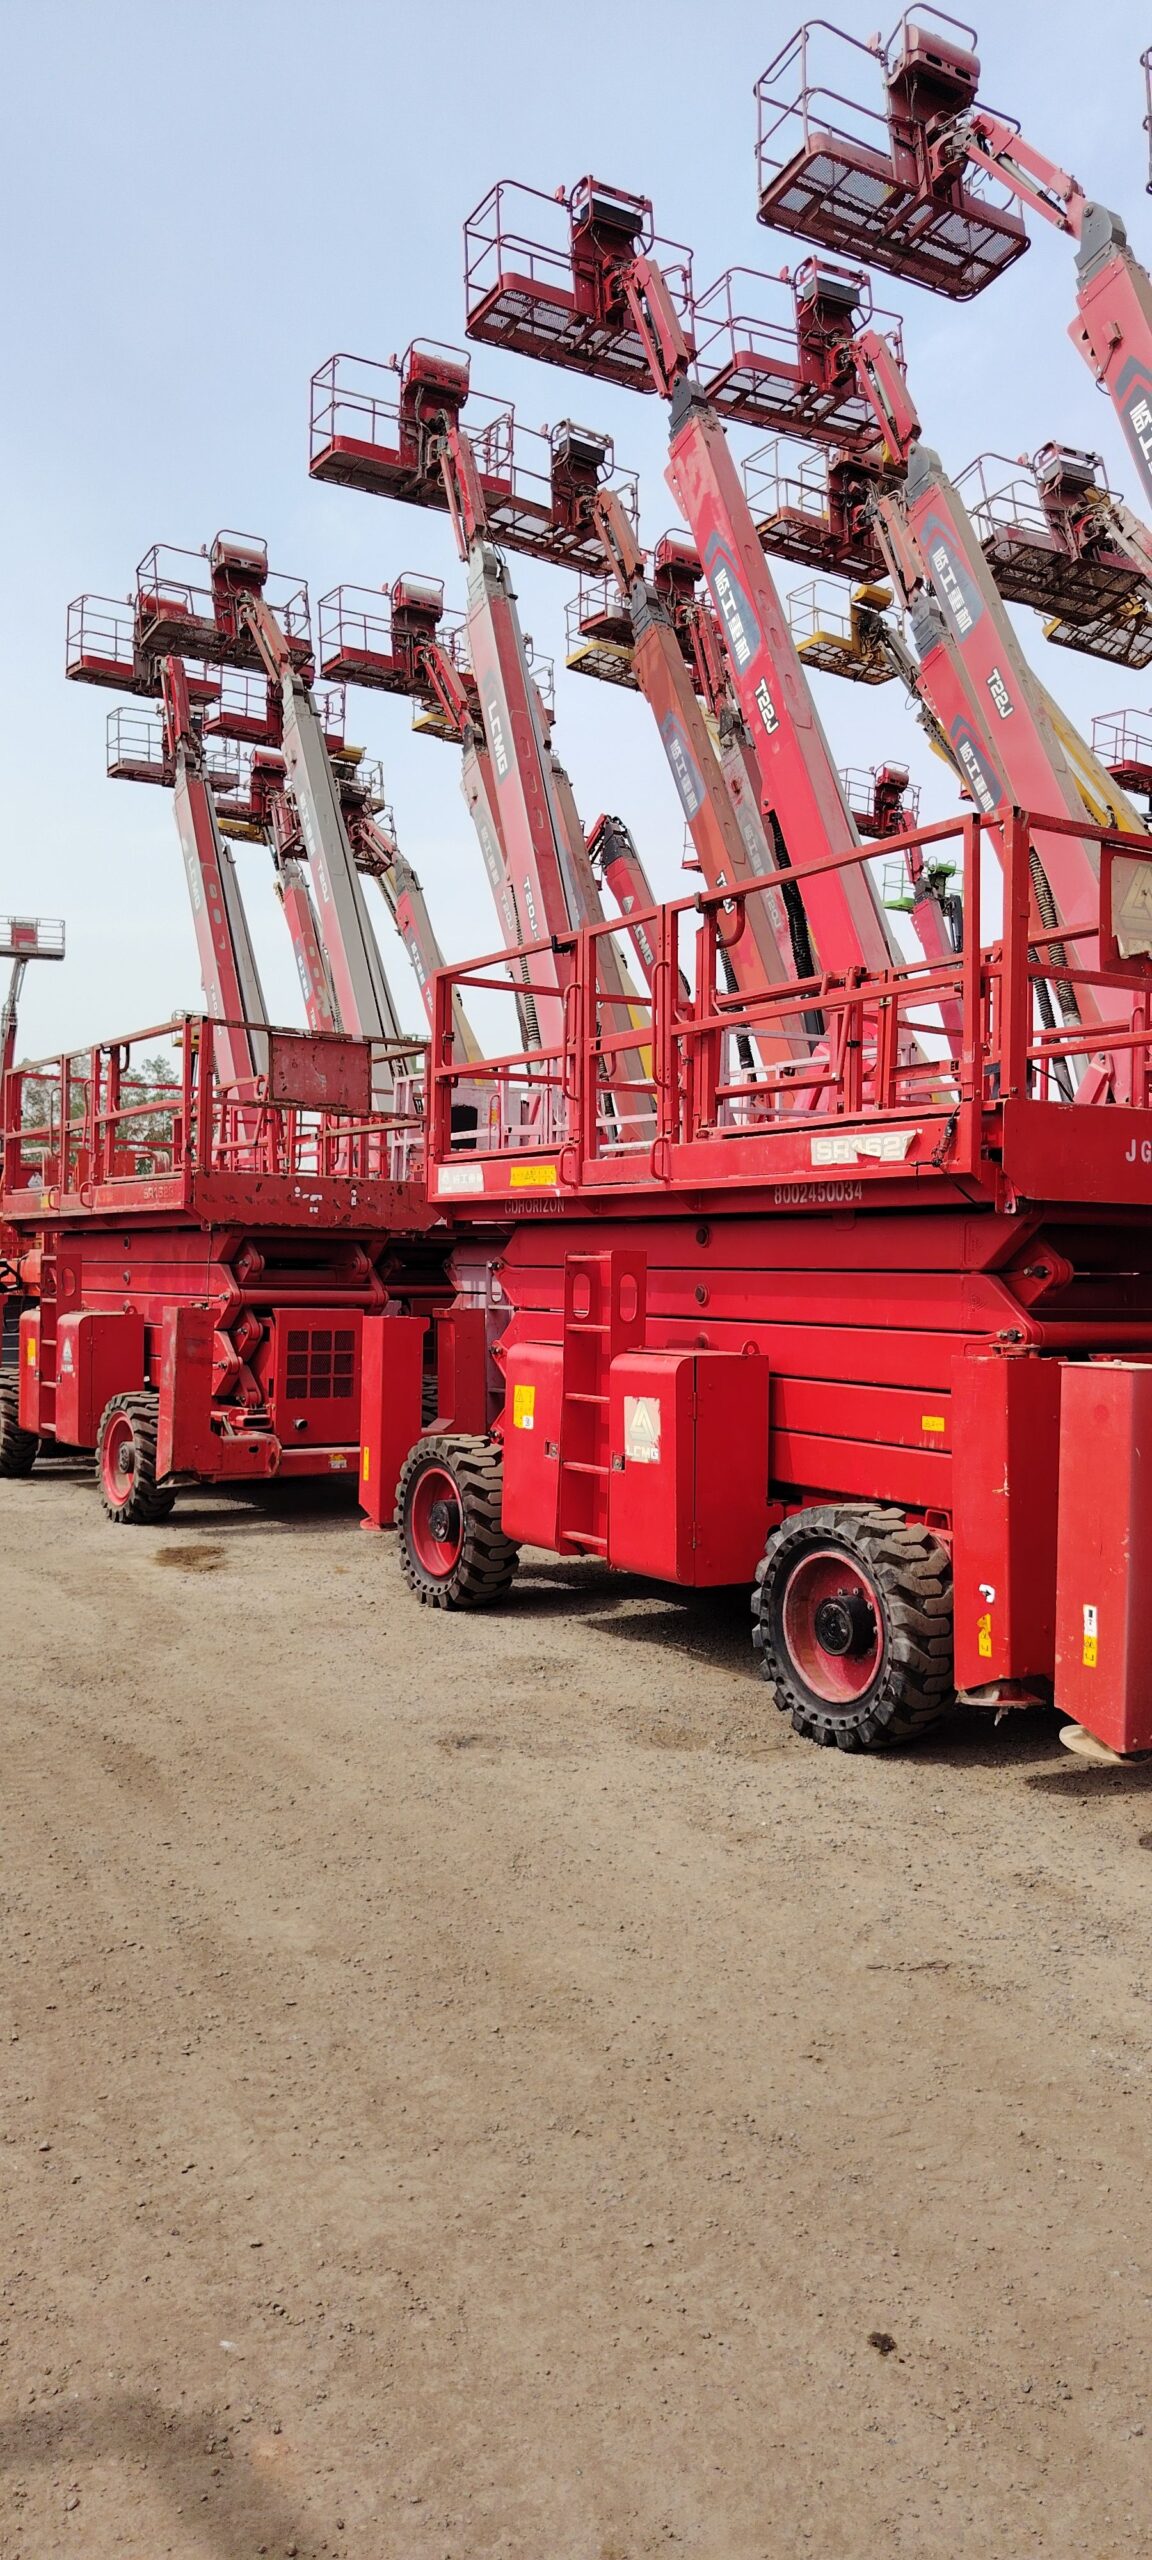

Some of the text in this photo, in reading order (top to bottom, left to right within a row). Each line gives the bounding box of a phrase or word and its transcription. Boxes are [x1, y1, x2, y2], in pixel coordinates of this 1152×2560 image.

[1129, 399, 1152, 475] 临工
[715, 568, 751, 665] 临工重机
[932, 546, 973, 633] 临工重机
[755, 679, 779, 734] T22J
[987, 668, 1013, 719] T22J
[488, 700, 508, 775] LCMG
[670, 738, 698, 813] 临工重机
[960, 741, 994, 812] 临工重机
[504, 1198, 565, 1214] CDHORIZON
[774, 1181, 863, 1204] 8002450034
